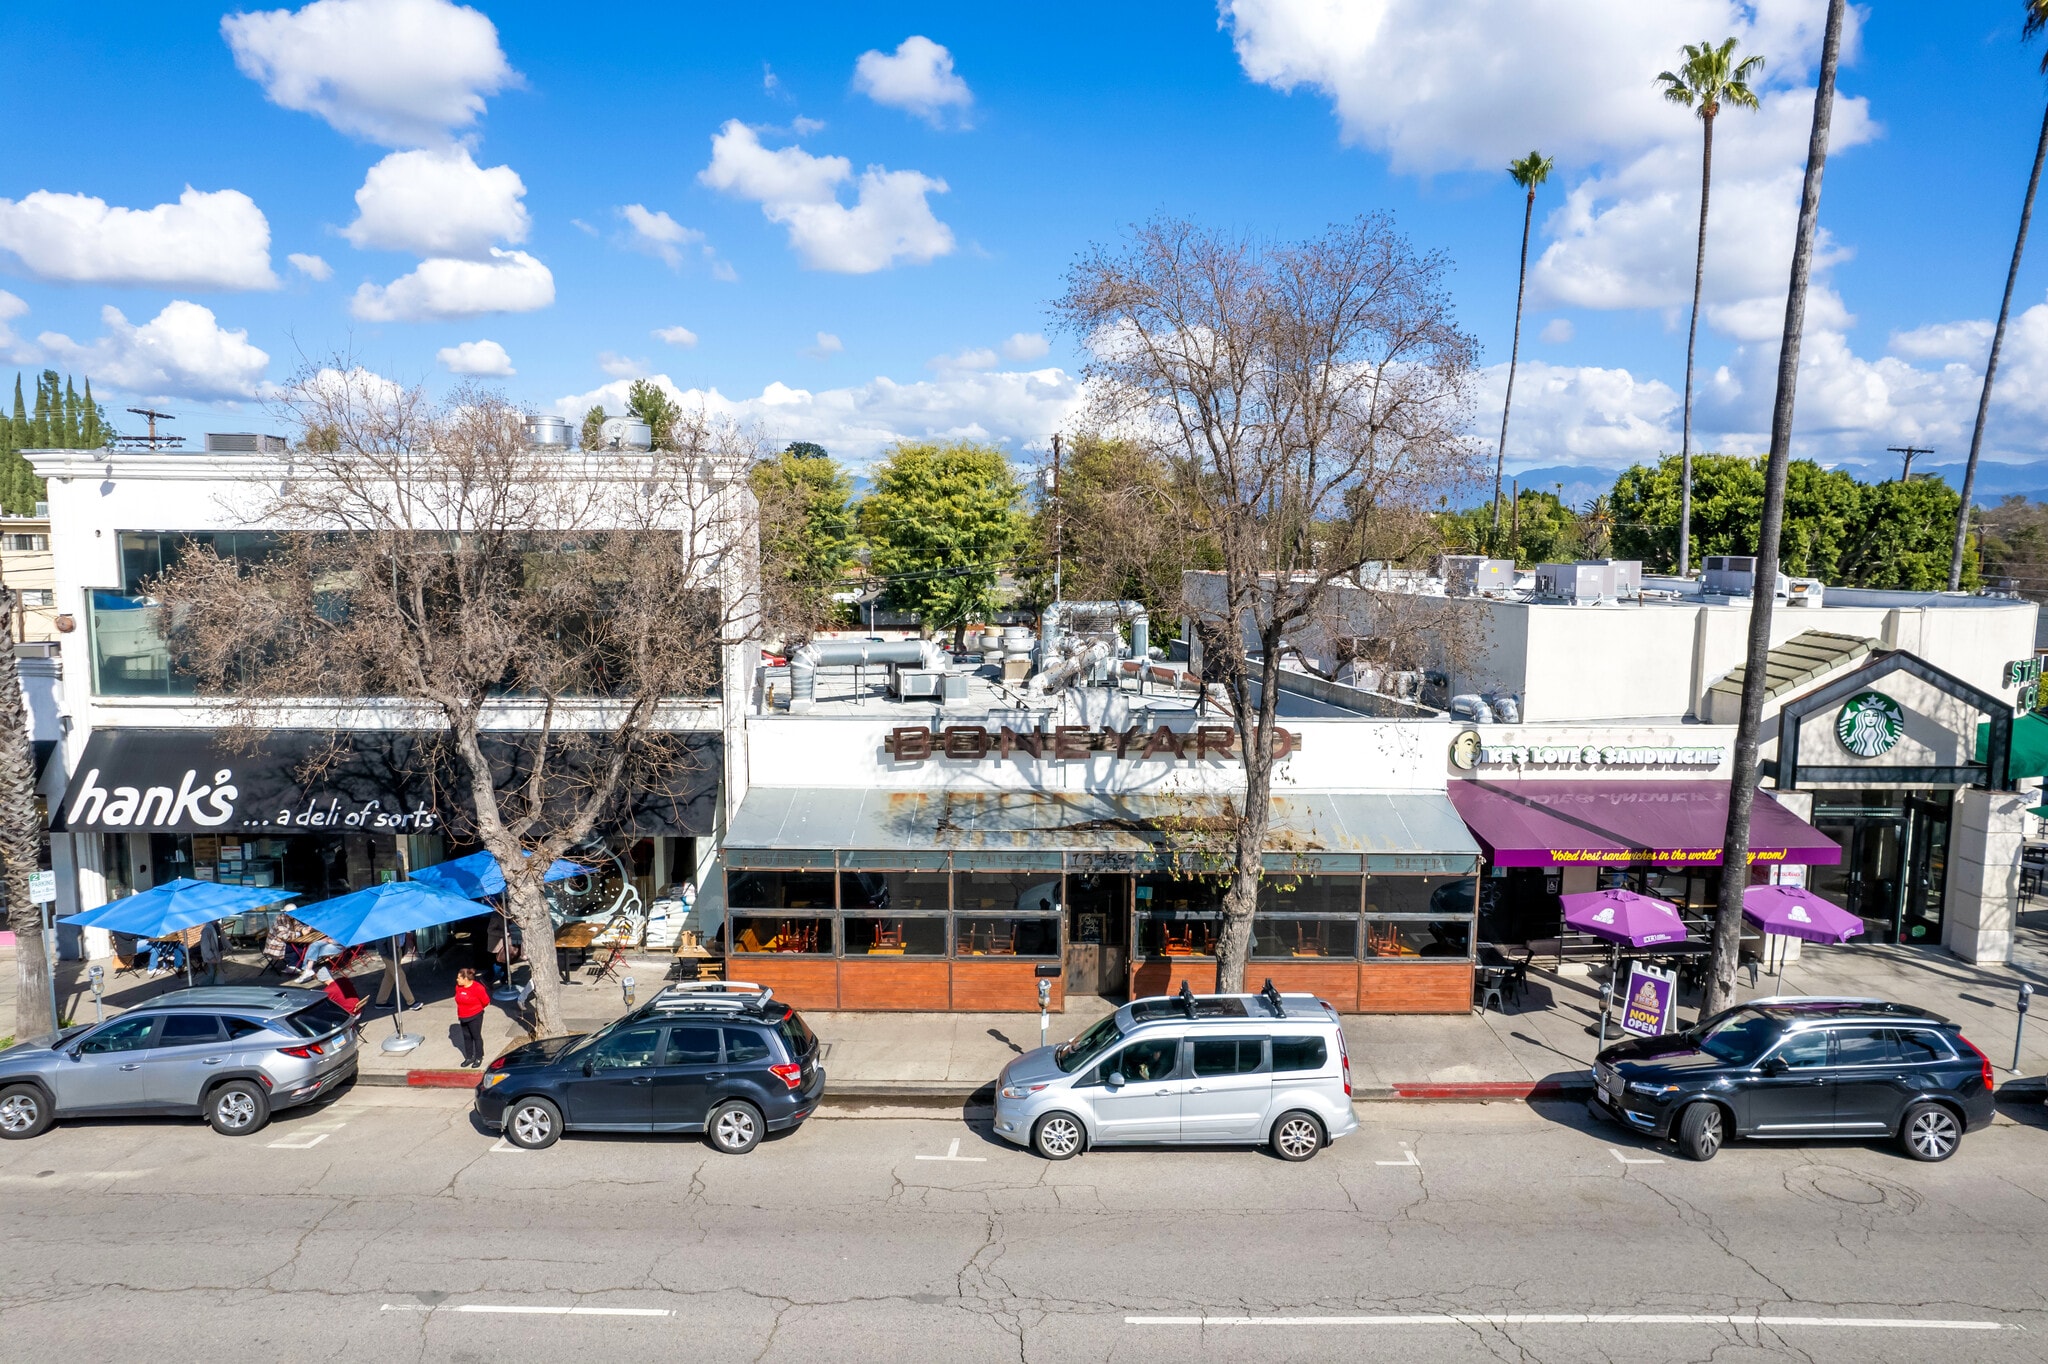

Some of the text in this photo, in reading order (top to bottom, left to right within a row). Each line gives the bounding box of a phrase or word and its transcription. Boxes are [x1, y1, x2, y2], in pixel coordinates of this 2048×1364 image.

[893, 725, 1291, 760] BONEYARD
[1529, 745, 1580, 764] LOVE
[1600, 745, 1728, 764] SANDWICHES
[67, 768, 238, 826] hank's
[277, 808, 290, 826] a
[296, 797, 339, 827] deli
[345, 800, 379, 827] of
[374, 801, 438, 828] sorts
[1580, 849, 1601, 861] best
[1602, 851, 1657, 861] sandwiches
[1658, 851, 1669, 860] in
[1671, 850, 1687, 861] the
[1627, 1018, 1658, 1034] OPEN
[1630, 1009, 1659, 1025] NOW
